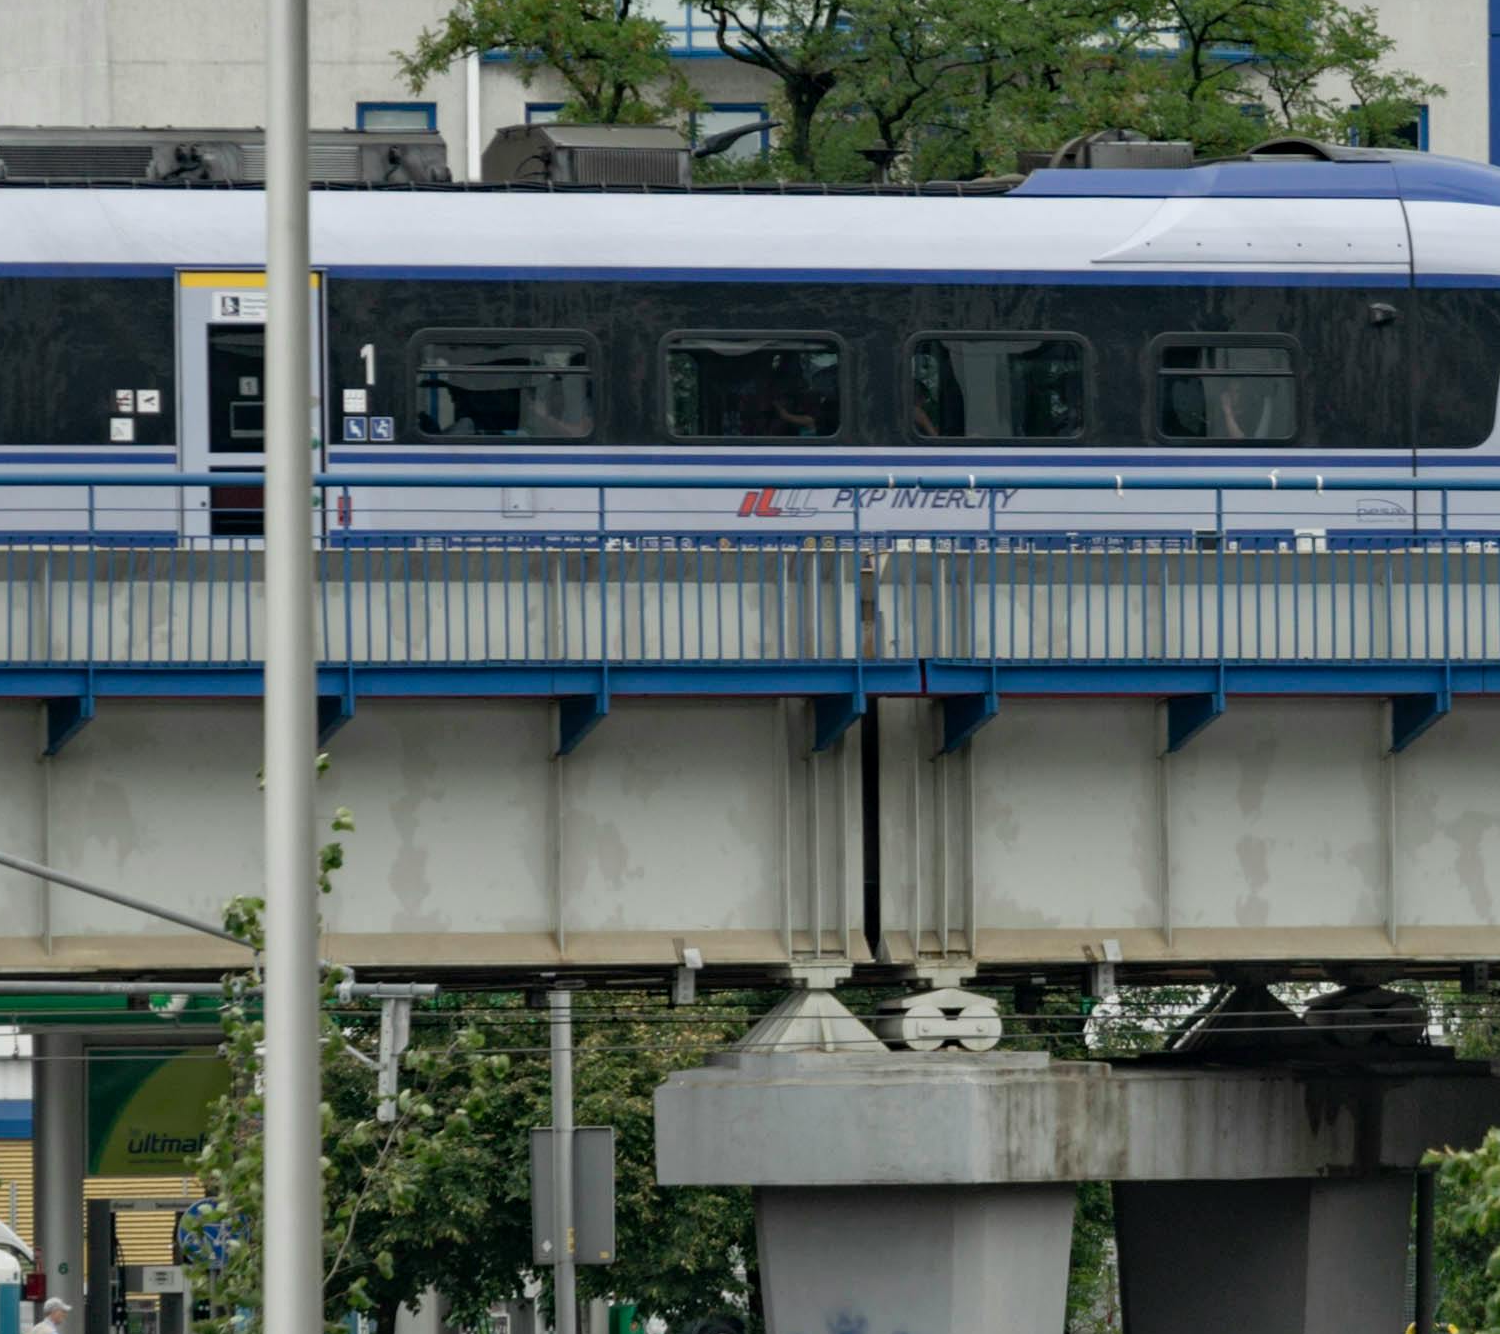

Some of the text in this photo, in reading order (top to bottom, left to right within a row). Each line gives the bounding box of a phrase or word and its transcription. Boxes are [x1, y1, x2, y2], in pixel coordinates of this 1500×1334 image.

[360, 343, 375, 386] 1
[832, 487, 1020, 510] PKP INTERCITY
[126, 1132, 209, 1155] ultimat
